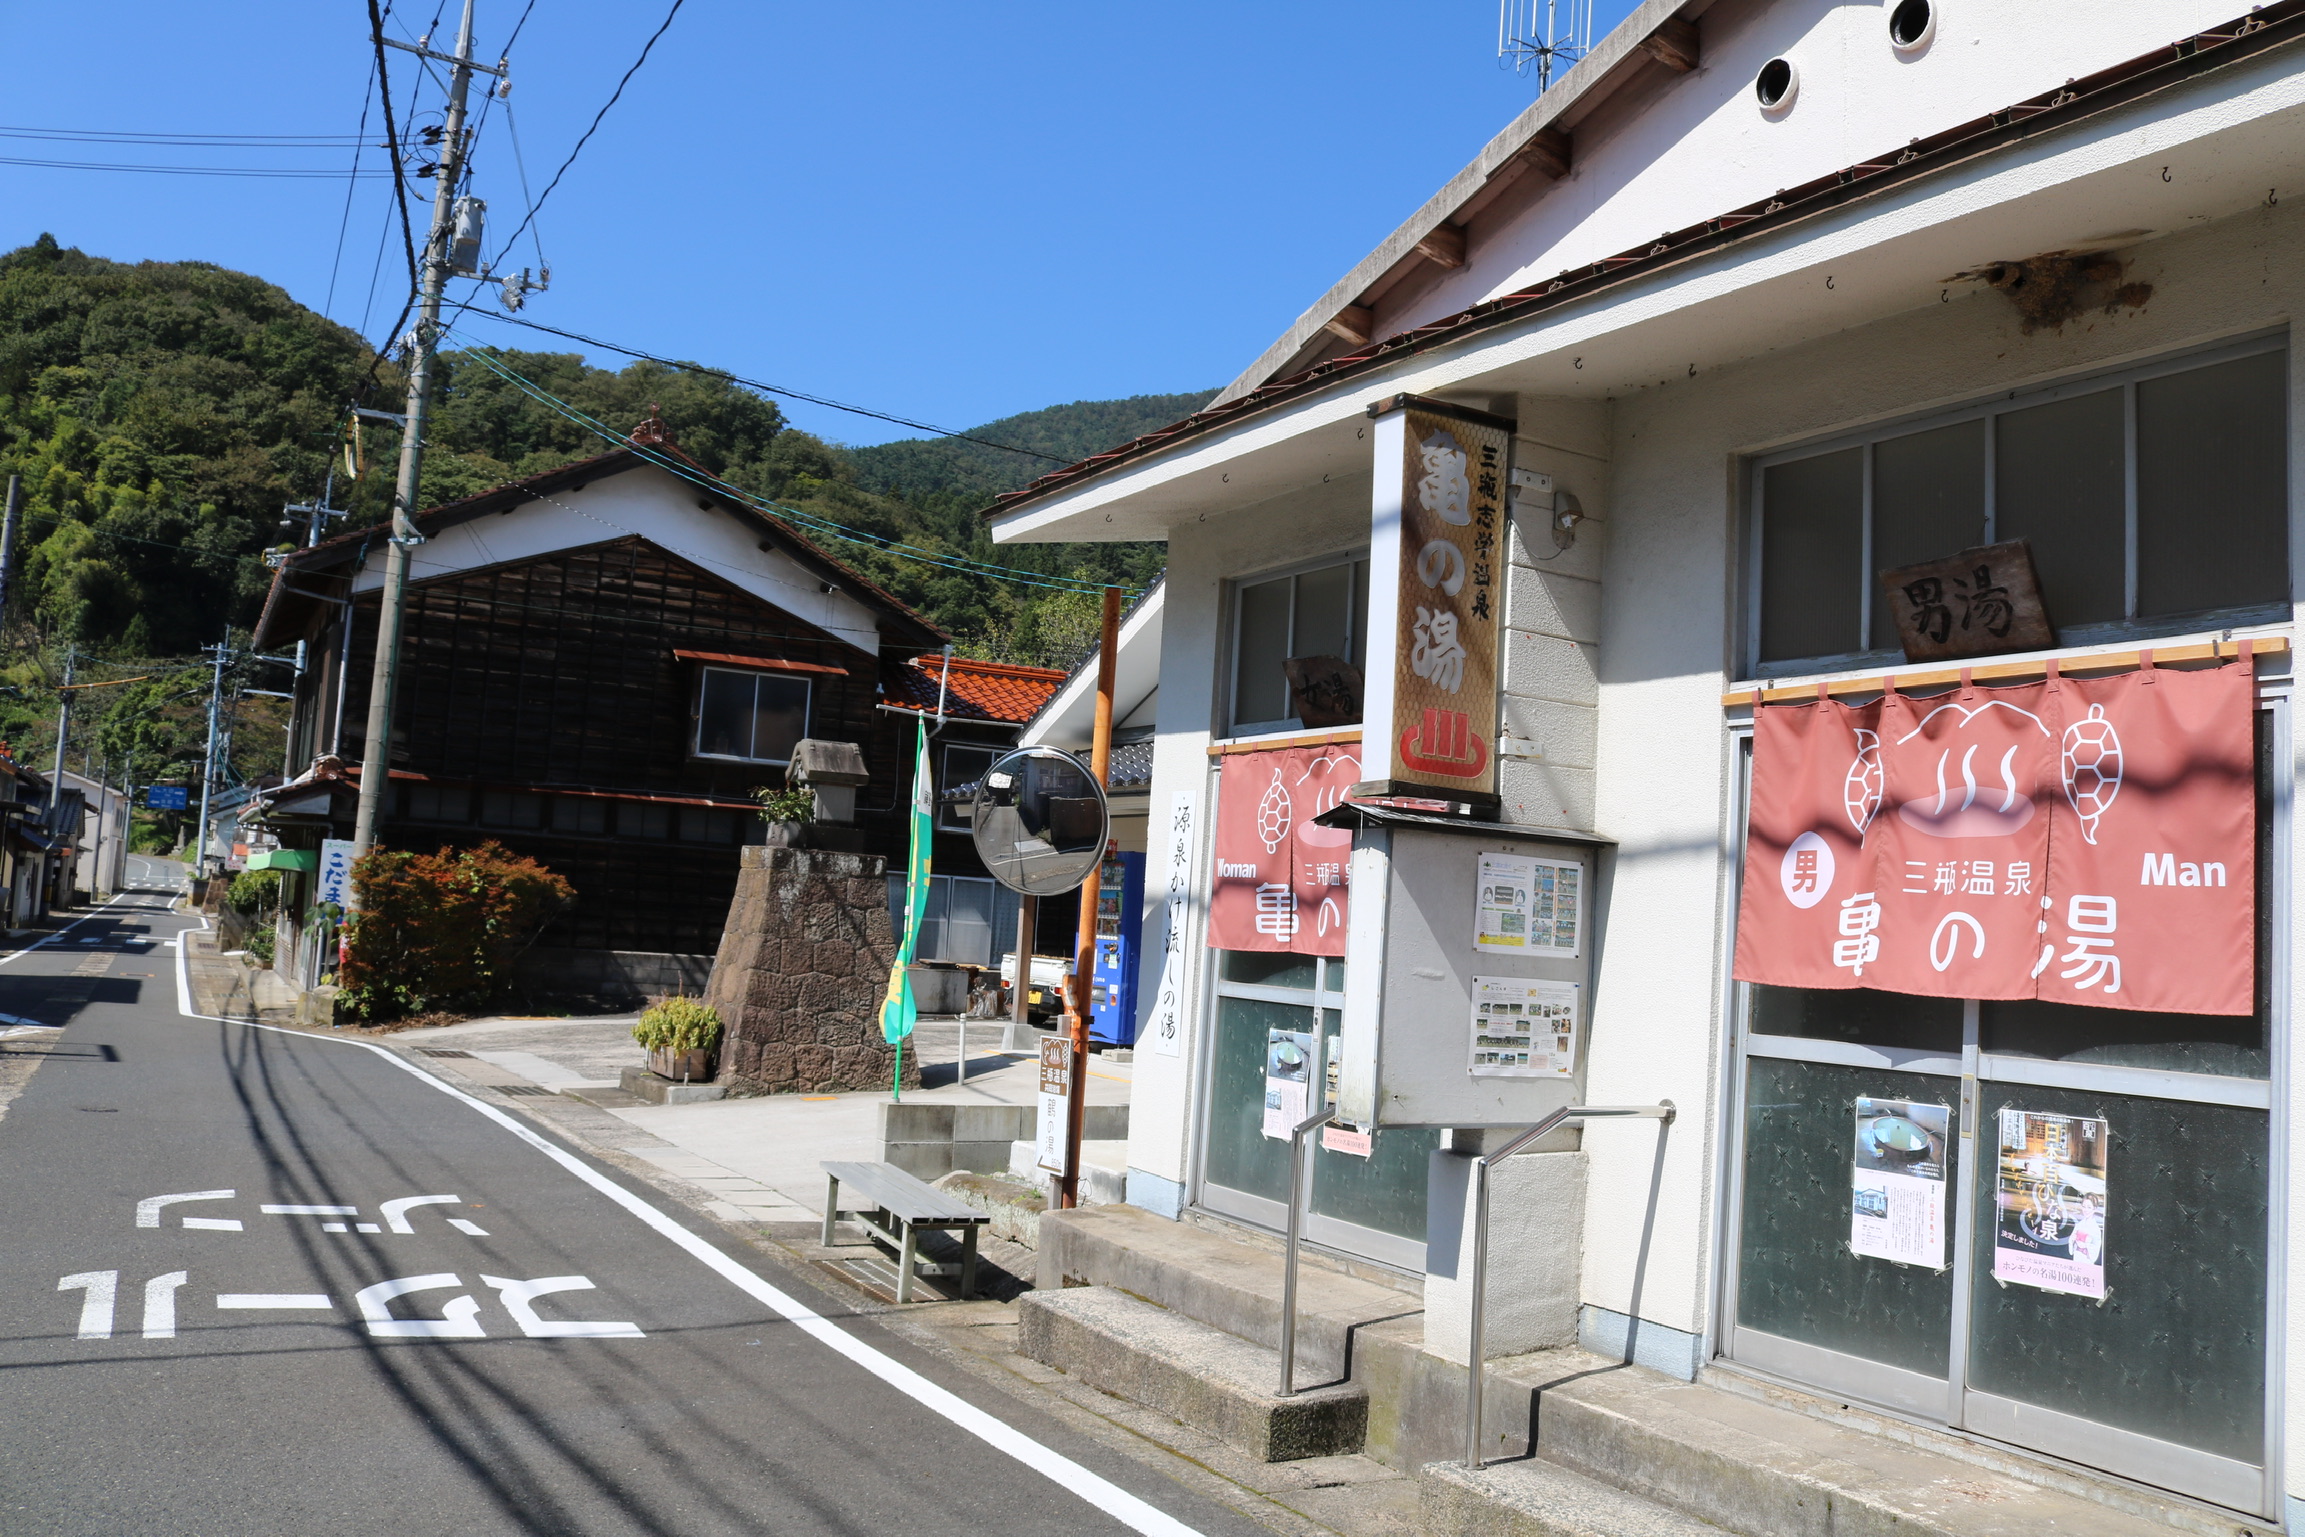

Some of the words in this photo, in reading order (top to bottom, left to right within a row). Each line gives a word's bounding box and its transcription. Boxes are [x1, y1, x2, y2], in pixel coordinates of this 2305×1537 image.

[1411, 428, 1472, 695] 亀の湯
[1470, 444, 1499, 623] 三瓶志学温泉
[1902, 563, 2014, 644] 男湯
[1216, 857, 1257, 879] Woman
[1791, 849, 1819, 895] 男
[1901, 859, 2032, 897] 三瓶温泉
[2140, 852, 2227, 888] Man
[1160, 805, 1192, 1041] 源泉かけ流しの湯
[1832, 890, 2121, 994] 亀の湯
